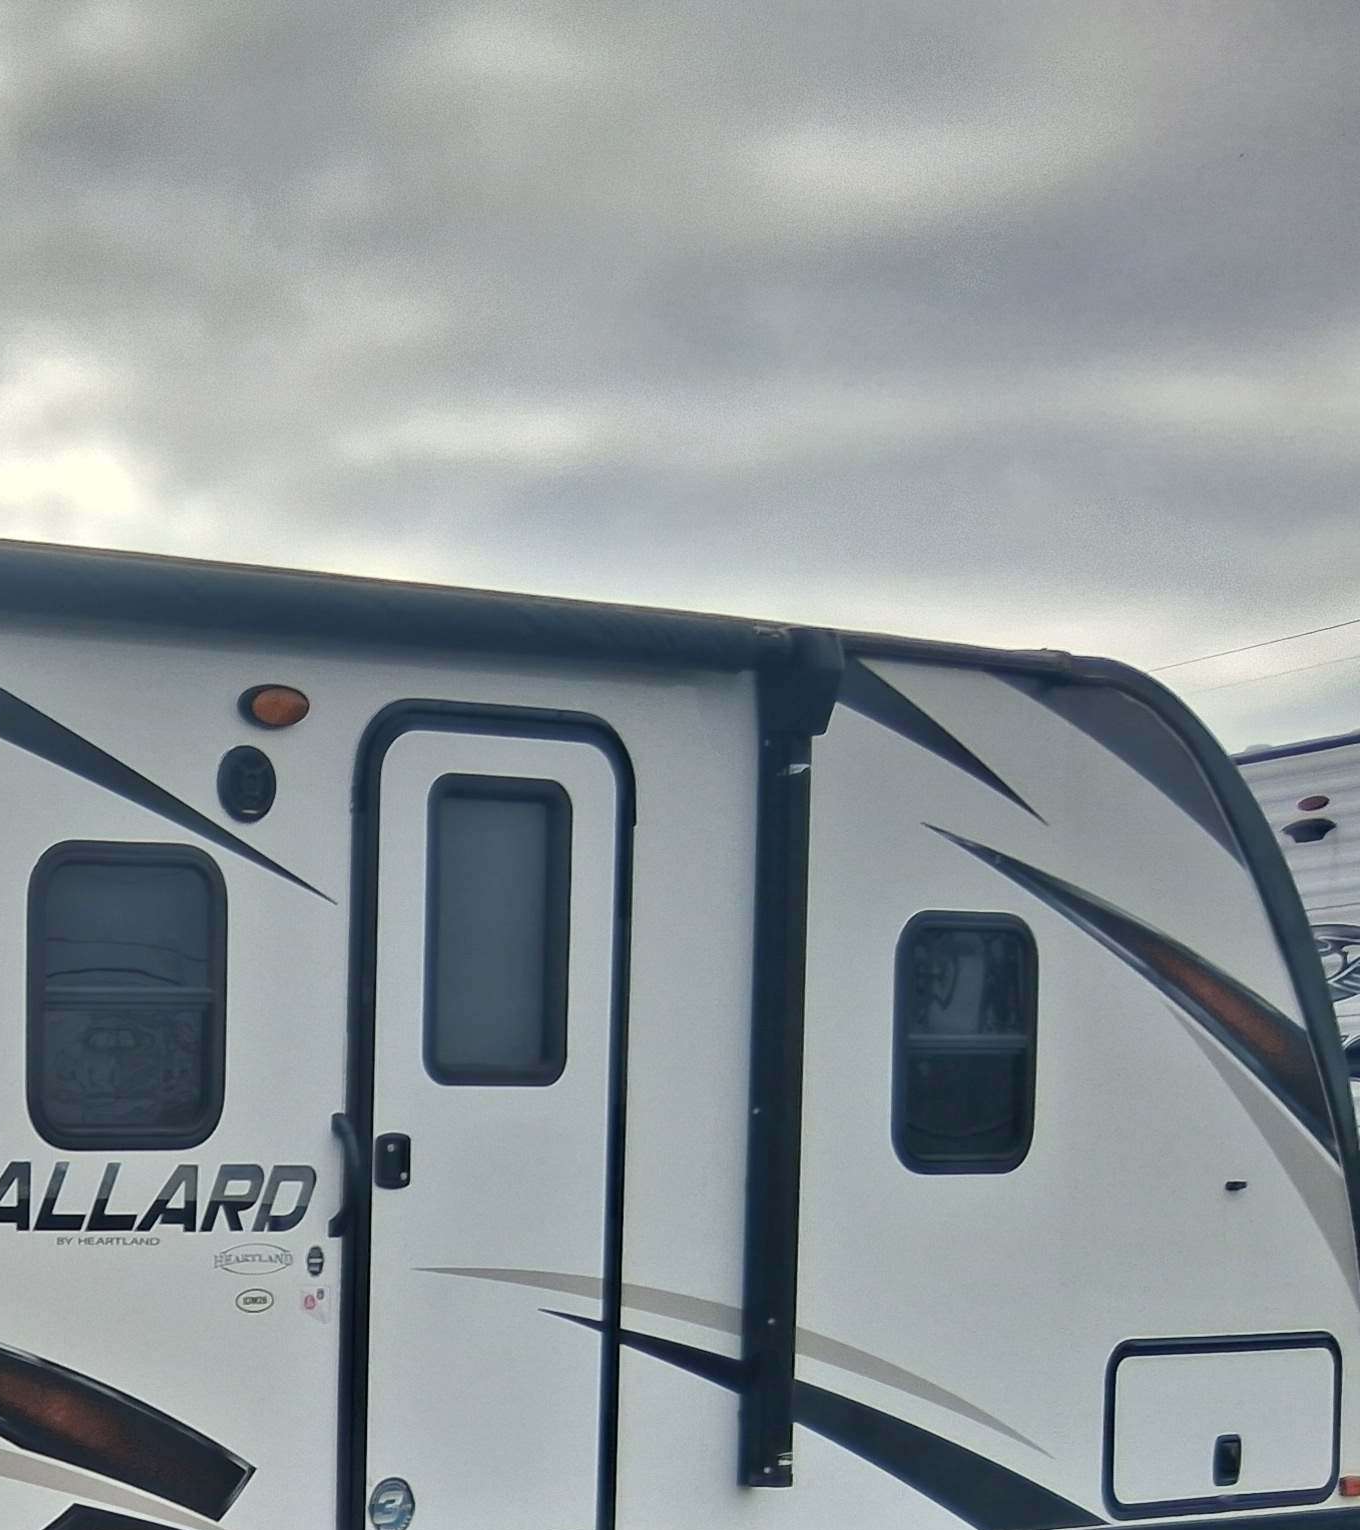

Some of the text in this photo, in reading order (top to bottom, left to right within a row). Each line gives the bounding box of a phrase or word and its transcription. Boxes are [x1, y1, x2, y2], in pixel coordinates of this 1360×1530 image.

[56, 1237, 161, 1246] BY HEARTLAND
[214, 1253, 294, 1269] HEARTLAND
[373, 1491, 404, 1525] 3
